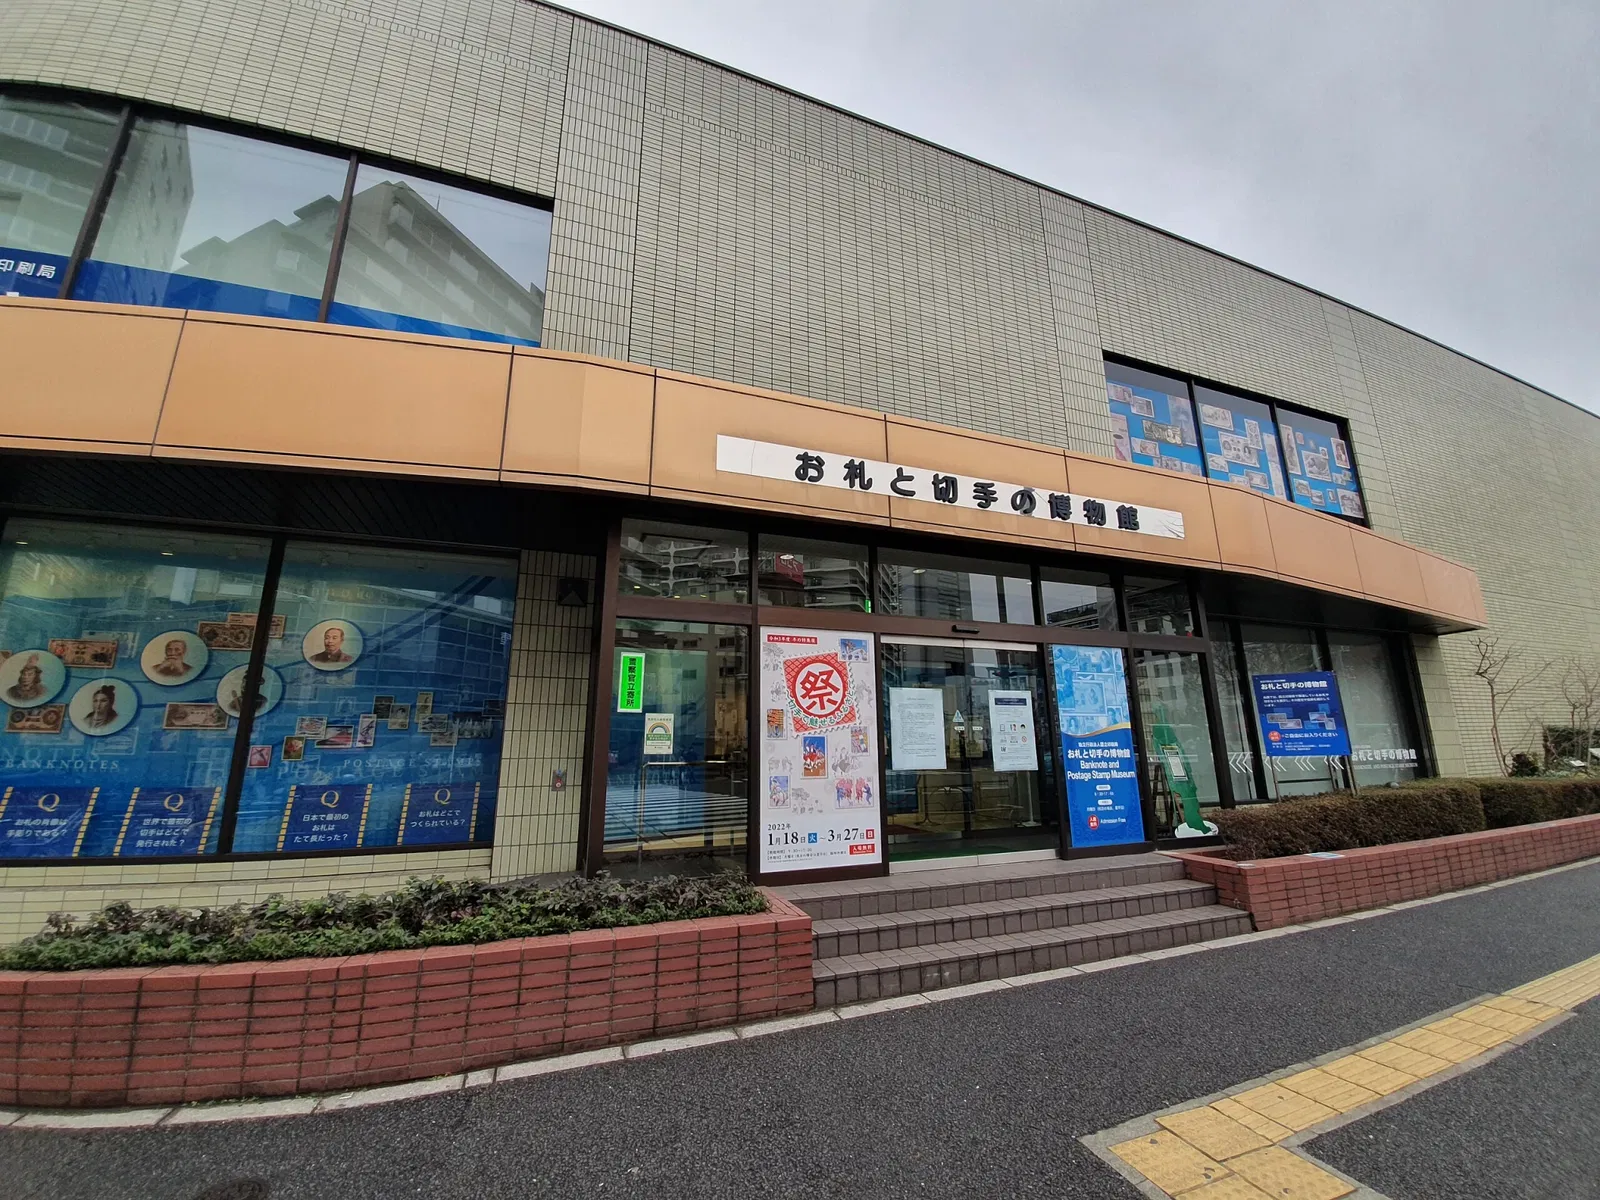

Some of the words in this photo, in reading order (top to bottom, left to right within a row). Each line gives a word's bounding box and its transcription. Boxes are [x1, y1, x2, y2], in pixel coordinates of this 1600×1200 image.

[794, 452, 1140, 530] お札と切手の博物館
[626, 657, 636, 708] 警察官立寄所
[1261, 680, 1328, 690] お札と切手の博物館
[800, 669, 841, 711] 祭
[1067, 748, 1131, 759] お札と切手の博物館
[1351, 748, 1417, 761] お札と切手の博物館
[1080, 760, 1108, 769] Banknote
[1109, 760, 1120, 768] and
[1067, 771, 1092, 782] Postage
[1092, 770, 1110, 780] Stamp
[1110, 769, 1136, 778] Museum
[37, 793, 61, 812] Q
[163, 793, 184, 812] Q
[320, 790, 340, 808] Q
[434, 788, 452, 805] Q
[302, 813, 349, 822] 日本で最初の
[418, 809, 461, 818] お札はどこで
[142, 817, 192, 826] 世界で最初の
[311, 823, 335, 832] お札は
[767, 822, 792, 831] 2022年
[139, 828, 190, 837] 切手はどこで
